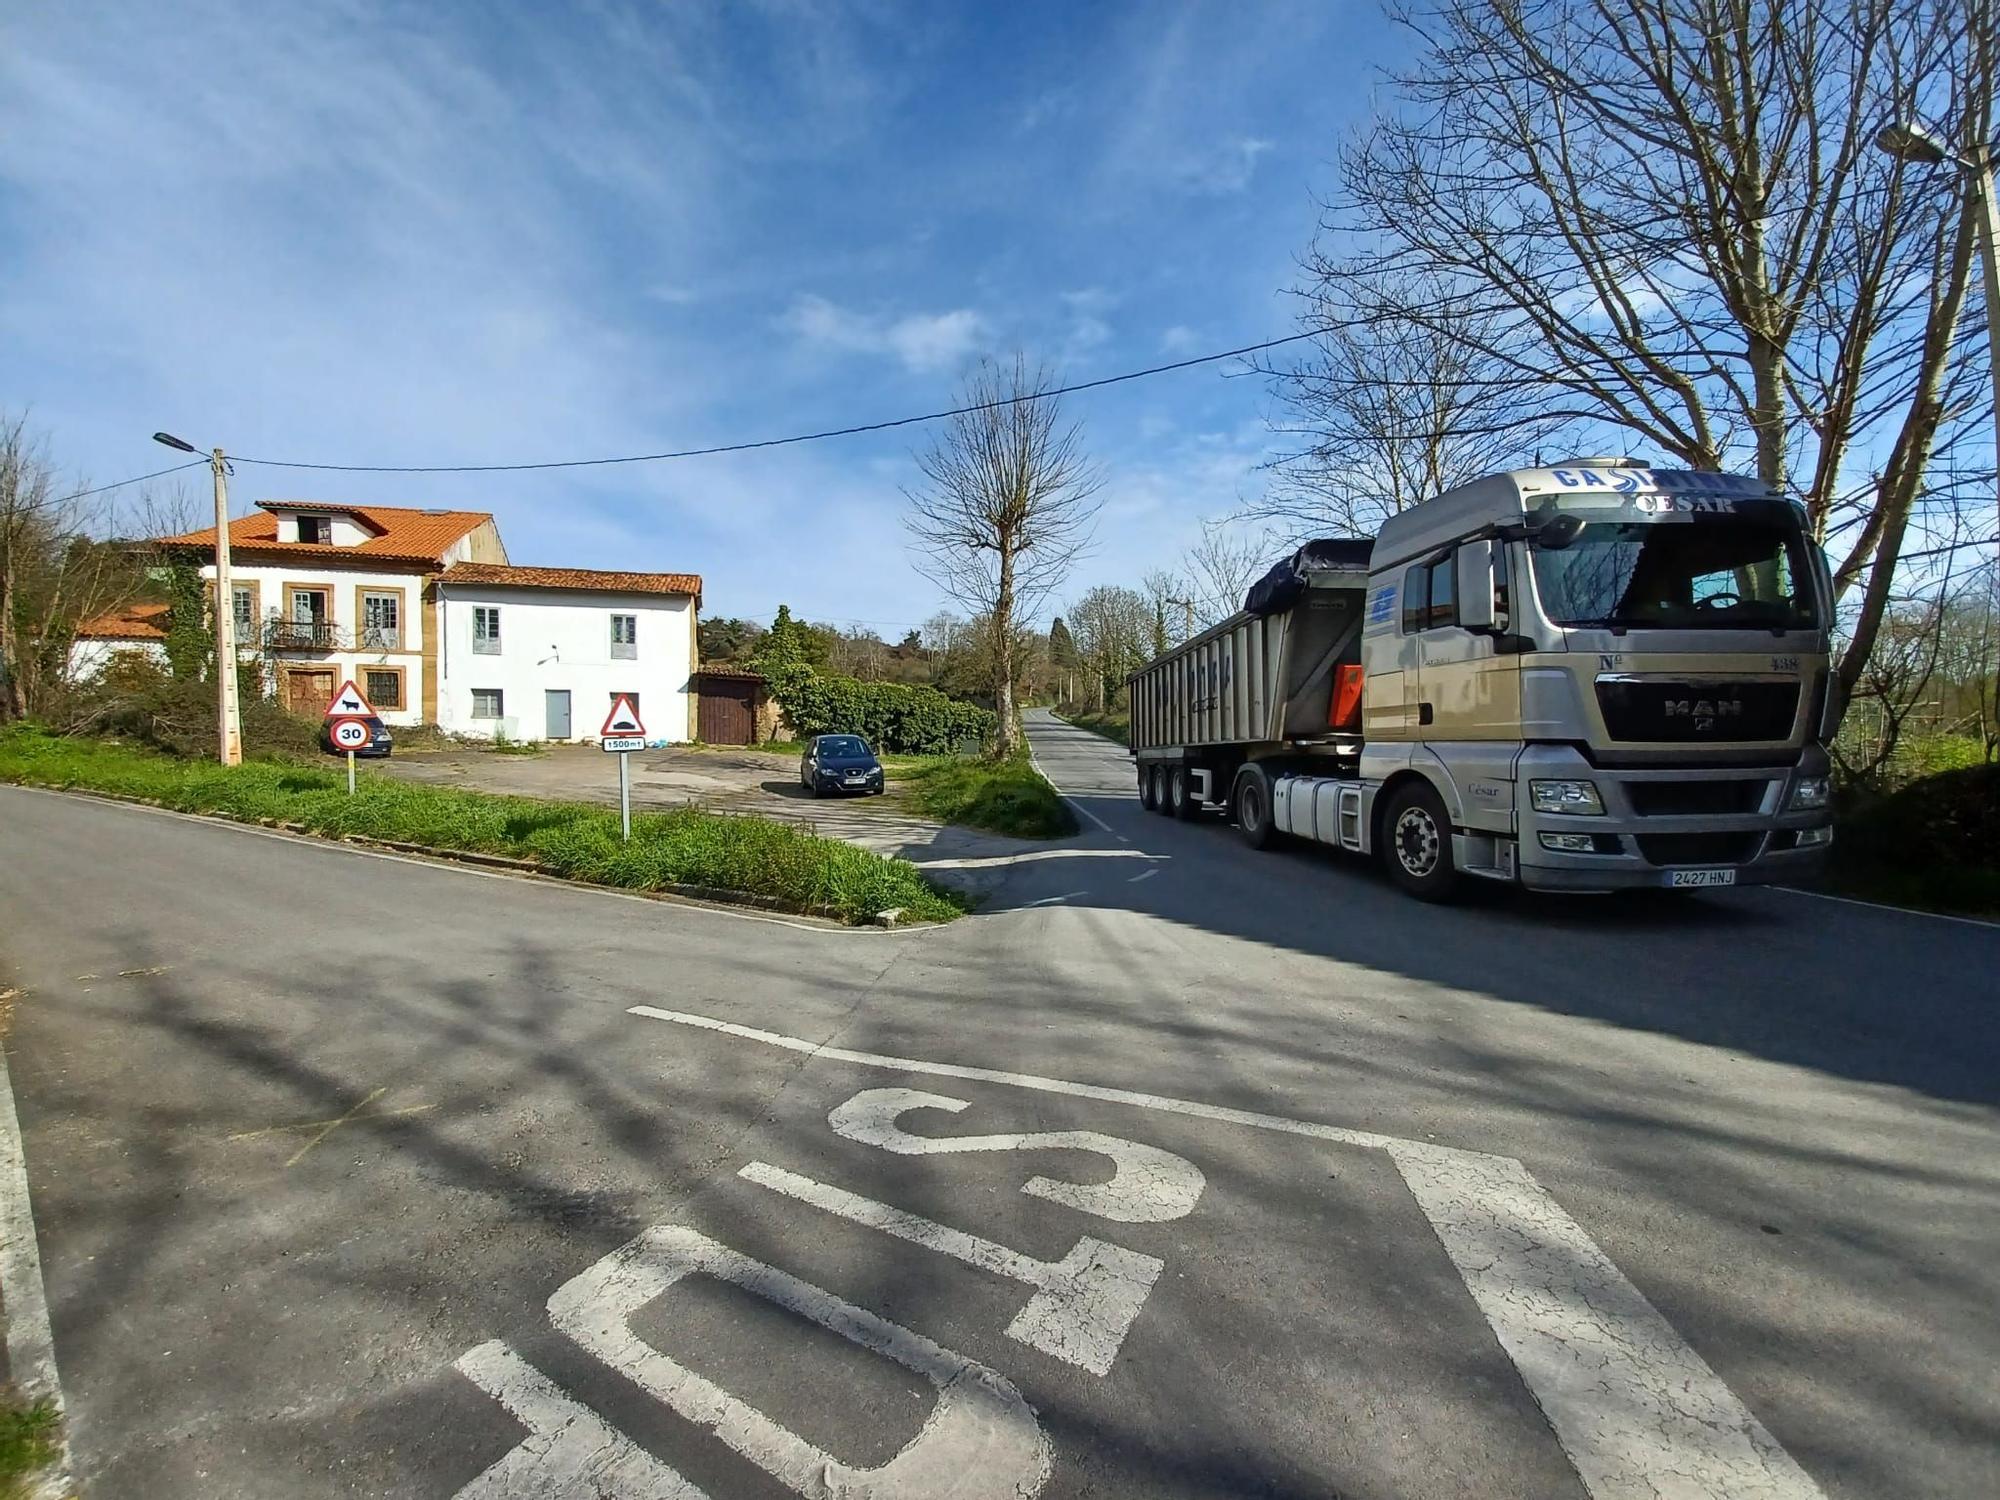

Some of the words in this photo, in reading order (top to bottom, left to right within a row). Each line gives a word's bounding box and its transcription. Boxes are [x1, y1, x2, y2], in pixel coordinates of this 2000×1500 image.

[1552, 468, 1745, 493] CASI
[1635, 495, 1737, 513] CESAR
[1664, 699, 1743, 716] MAN
[342, 729, 361, 740] 30
[1674, 872, 1706, 885] 2427
[1709, 871, 1733, 884] HNJ
